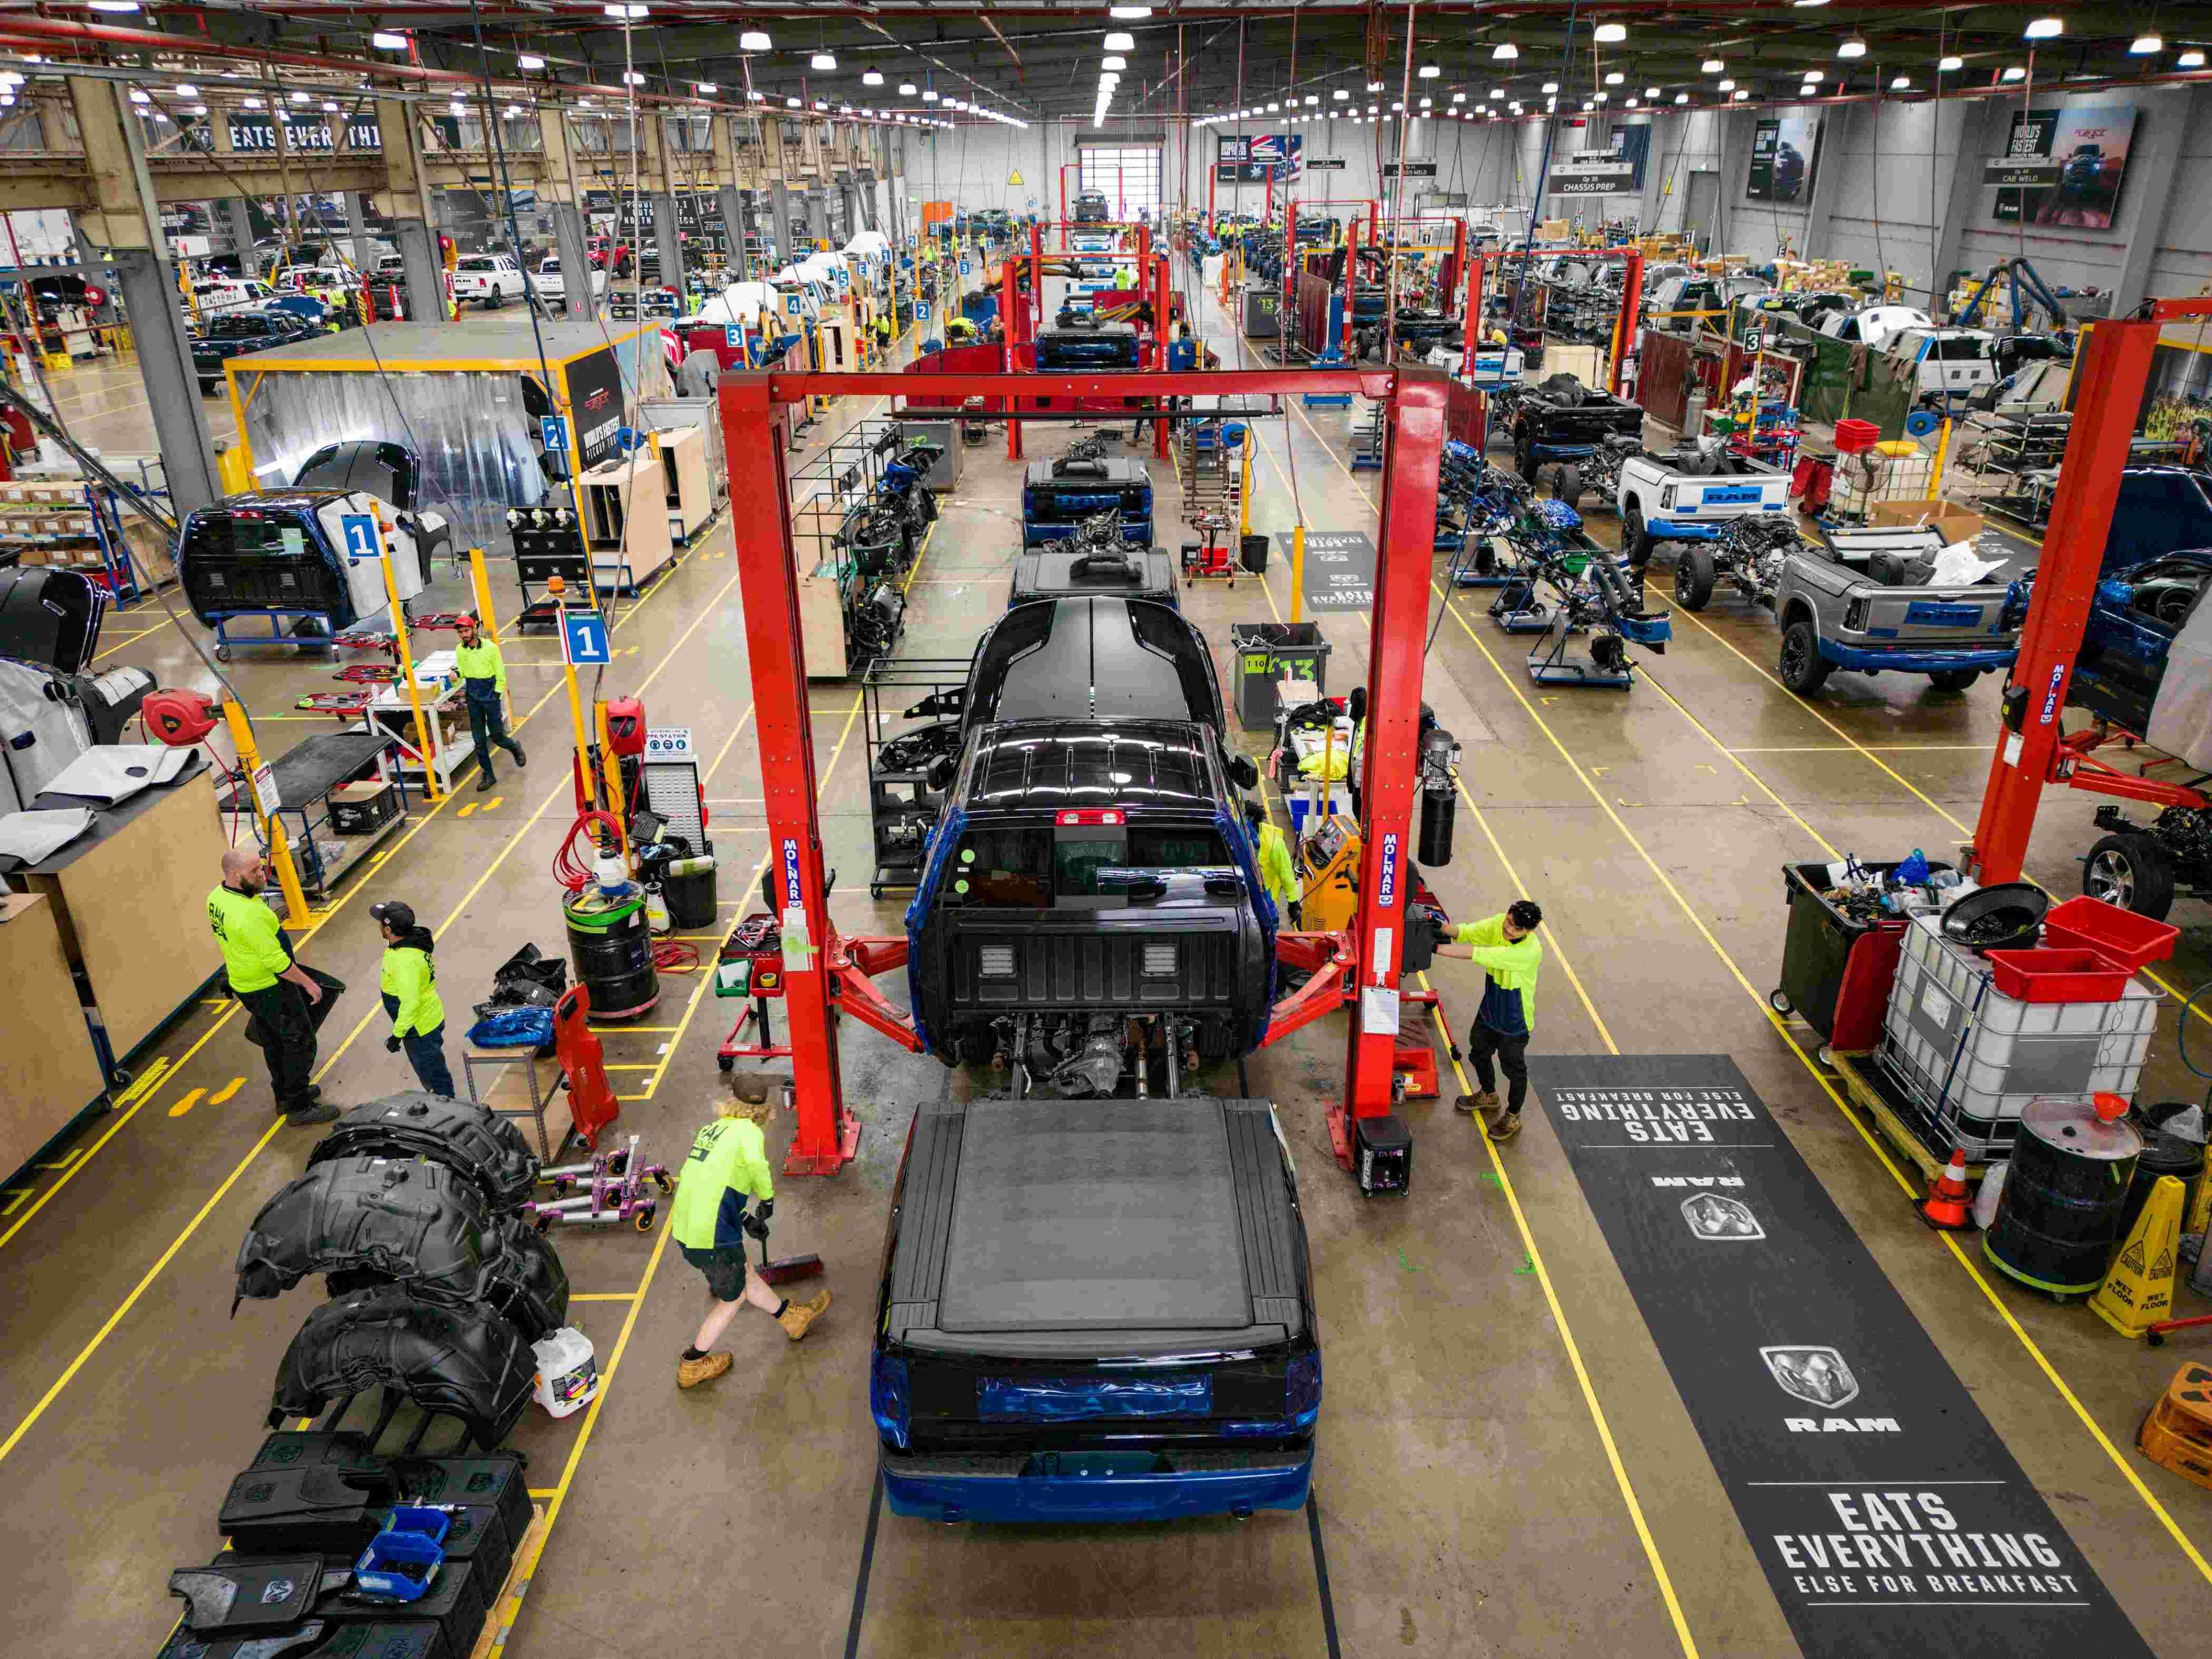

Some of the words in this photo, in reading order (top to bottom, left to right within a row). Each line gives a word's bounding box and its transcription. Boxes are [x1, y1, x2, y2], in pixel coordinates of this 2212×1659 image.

[229, 126, 276, 147] EATS
[1575, 217, 1580, 225] 3
[1685, 234, 1690, 242] 1
[883, 252, 890, 262] 1
[1778, 247, 1786, 257] E
[858, 266, 865, 275] E
[961, 264, 968, 274] 3
[839, 275, 848, 285] 5
[789, 300, 799, 313] 4
[919, 306, 927, 318] 2
[730, 329, 740, 345] 3
[1747, 333, 1759, 351] 3
[547, 425, 564, 447] 2
[583, 425, 603, 448] WORLD'S
[603, 415, 620, 437] FASTEST
[351, 525, 374, 554] 1
[577, 626, 600, 656] 1
[784, 839, 800, 900] MOLNAR
[1381, 834, 1397, 894] MOLNAR
[209, 902, 225, 926] RAM
[1556, 1092, 1653, 1102] BREAKFAST
[1661, 1092, 1694, 1101] FOR
[1700, 1091, 1743, 1100] ELSE
[1560, 1103, 1756, 1121] EVERYTHING
[1624, 1120, 1715, 1142] EATS
[1362, 1149, 1373, 1190] ENFORCER
[1651, 1177, 1746, 1187] RAM
[2120, 1254, 2144, 1278] CAUTION
[2148, 1269, 2172, 1281] CAUTION
[2107, 1282, 2133, 1307] FLOOR
[2115, 1278, 2133, 1295] WET
[2147, 1292, 2166, 1302] WET
[2141, 1300, 2168, 1311] FLOOR
[1783, 1418, 1901, 1432] RAM
[1827, 1493, 1958, 1531] EATS
[1773, 1533, 2062, 1568] EVERYTHING
[1793, 1575, 1858, 1593] ELSE
[1866, 1575, 1918, 1593] FOR
[1926, 1574, 2080, 1593] BREAKFAST
